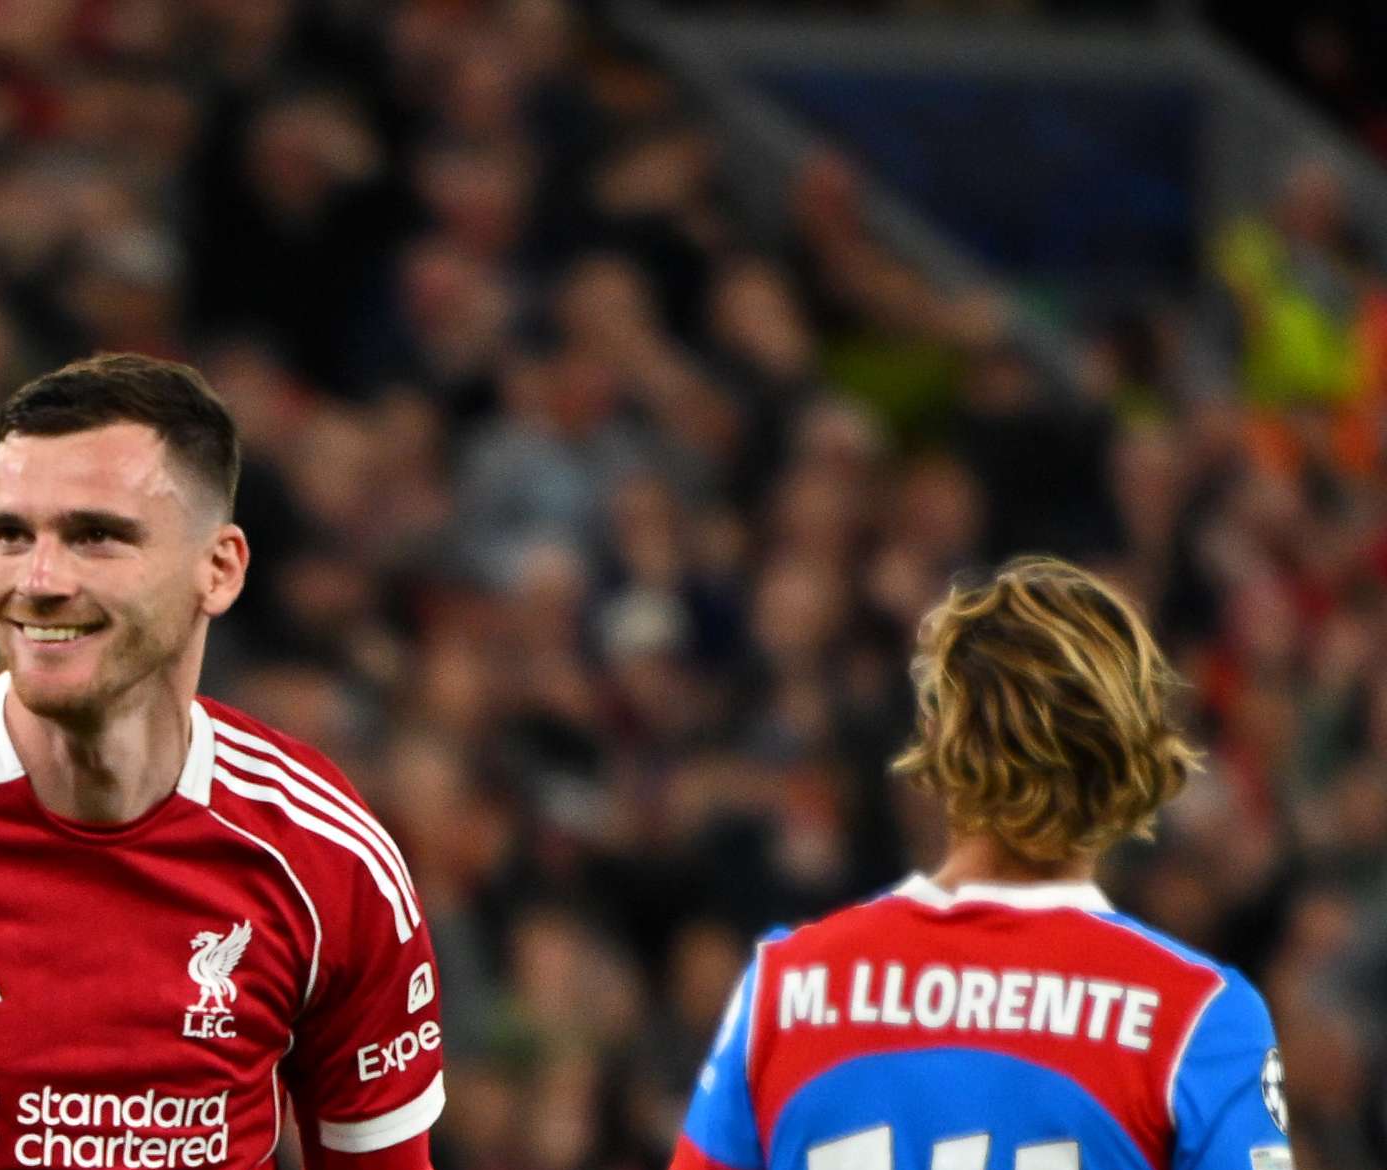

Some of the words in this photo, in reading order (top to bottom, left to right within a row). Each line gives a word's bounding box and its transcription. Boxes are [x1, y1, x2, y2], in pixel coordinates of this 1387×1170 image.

[780, 967, 837, 1030] M.
[849, 964, 1159, 1051] LLORENTE
[357, 1020, 442, 1082] Expe
[16, 1084, 229, 1129] standard
[14, 1123, 229, 1169] chartered
